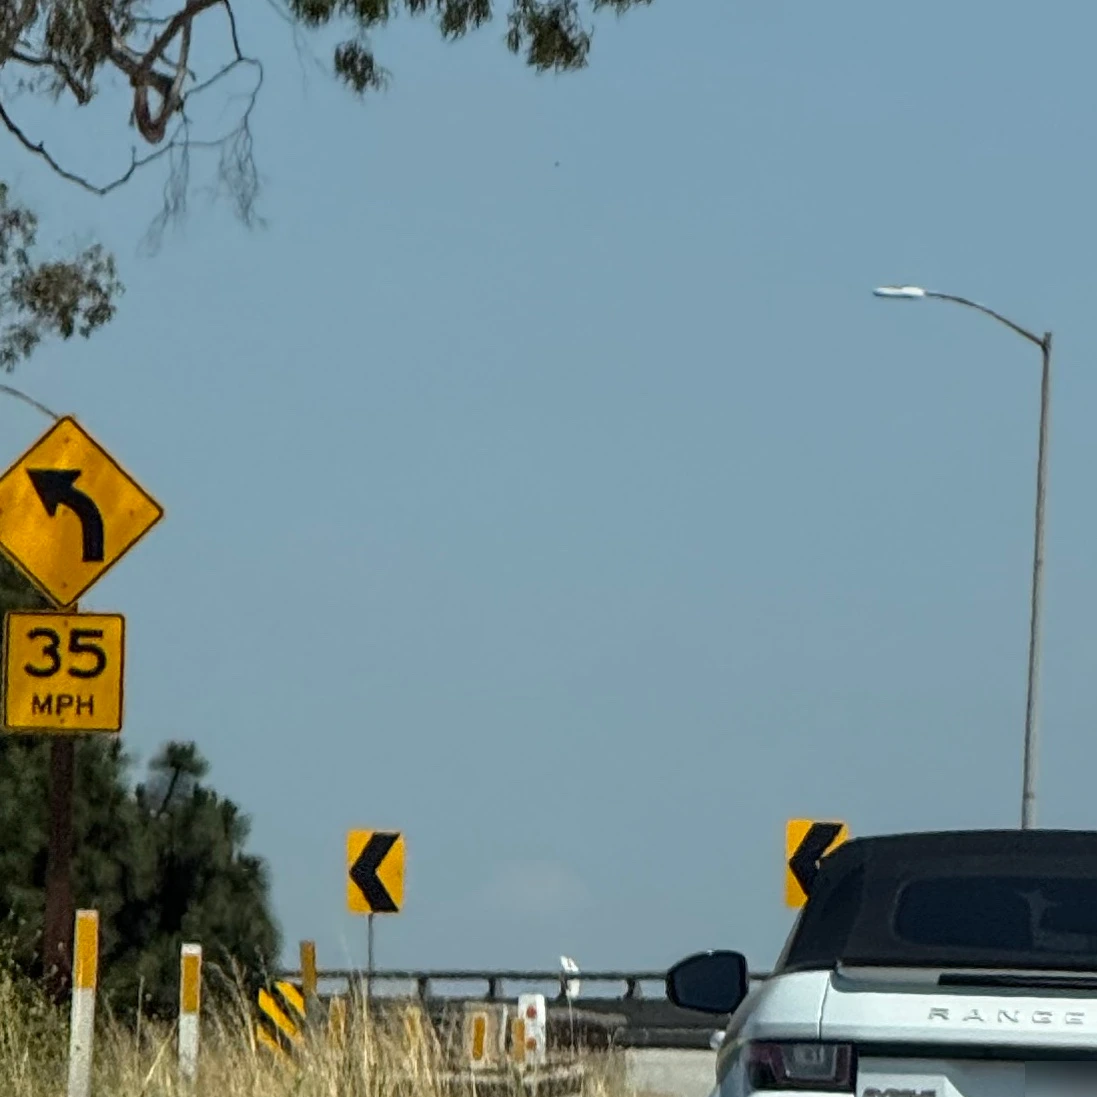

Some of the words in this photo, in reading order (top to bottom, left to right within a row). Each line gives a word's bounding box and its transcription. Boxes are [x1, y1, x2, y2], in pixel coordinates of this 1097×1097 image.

[24, 627, 107, 679] 35
[31, 693, 94, 716] MPH
[927, 1007, 1085, 1025] RANGE
